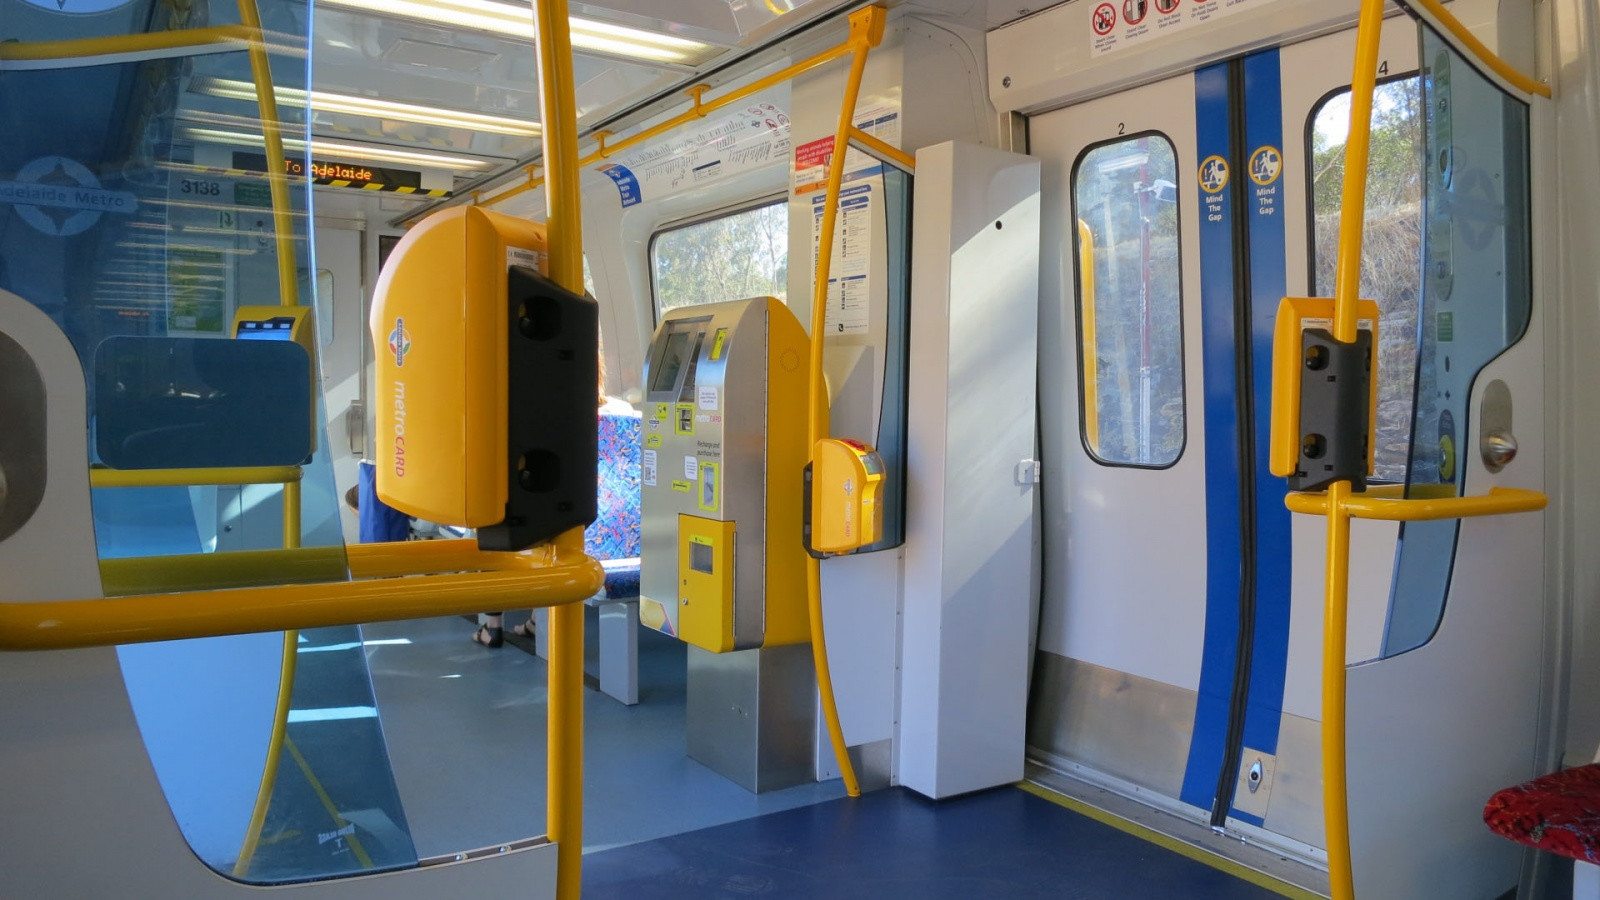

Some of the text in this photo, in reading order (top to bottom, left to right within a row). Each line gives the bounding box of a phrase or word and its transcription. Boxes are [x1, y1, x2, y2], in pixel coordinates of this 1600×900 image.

[1379, 60, 1389, 75] 4
[1118, 122, 1125, 135] 2
[284, 160, 373, 181] To Adelaide
[181, 179, 220, 197] 3138
[1257, 186, 1276, 197] Mind
[75, 191, 125, 207] Metro
[1206, 194, 1223, 204] Mind
[1259, 197, 1273, 206] The
[1208, 205, 1221, 213] The
[1259, 207, 1274, 216] Gap
[1208, 214, 1222, 223] Gap
[394, 381, 406, 477] metroCARD
